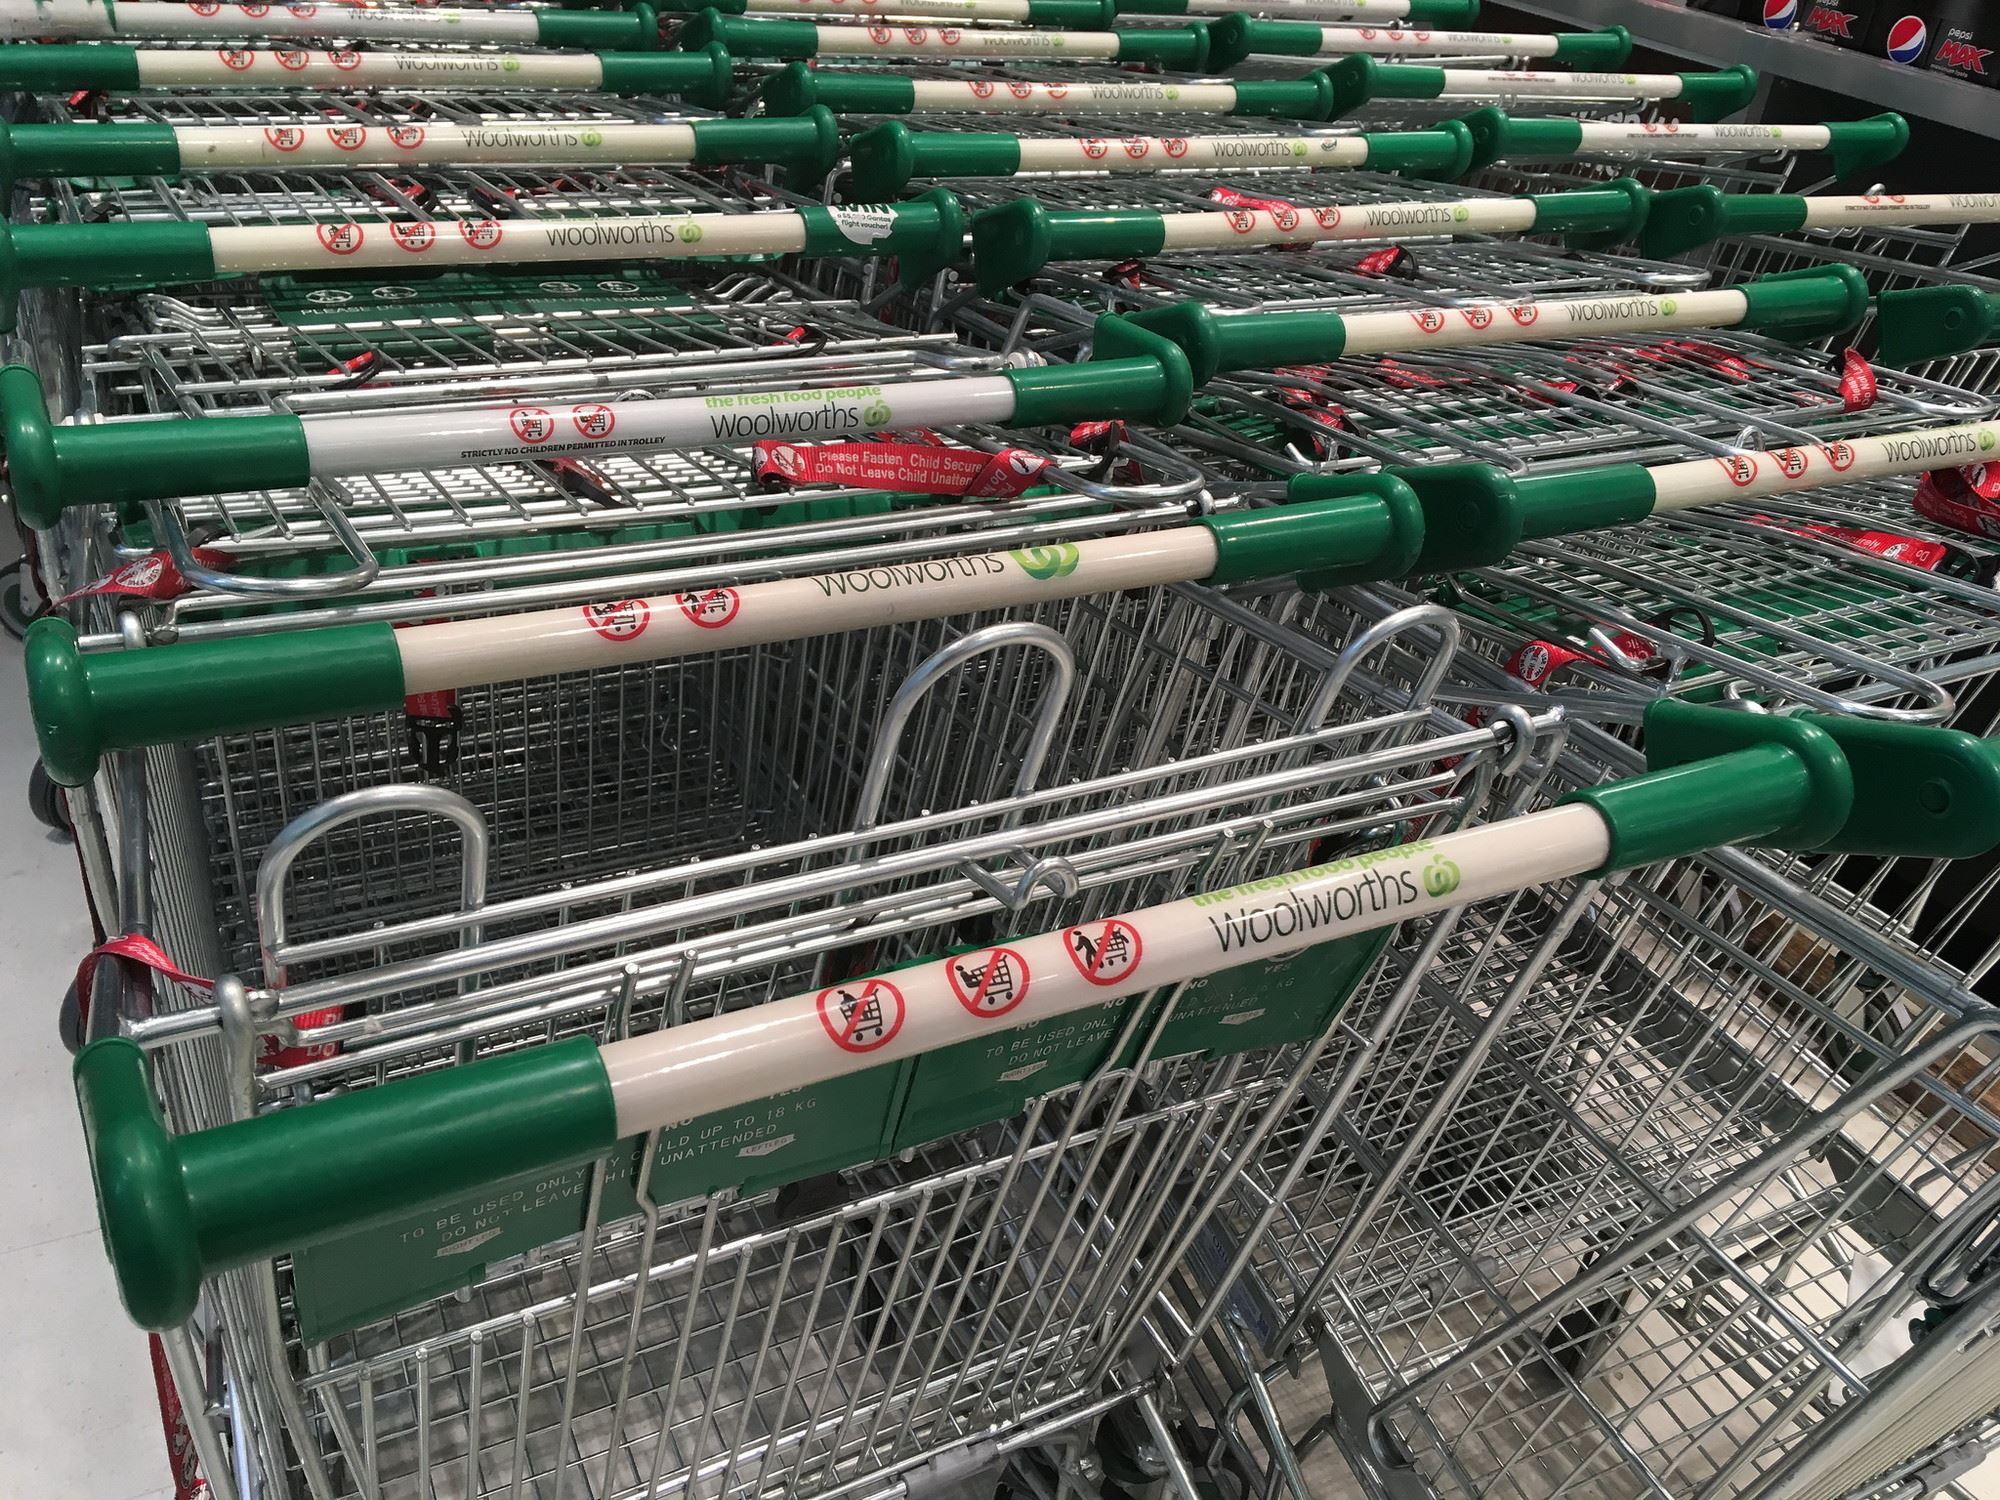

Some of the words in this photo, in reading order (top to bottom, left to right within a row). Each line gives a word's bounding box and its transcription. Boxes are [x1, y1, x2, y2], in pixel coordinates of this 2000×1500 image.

[1805, 5, 1859, 38] MAX
[1947, 28, 1974, 40] pepsi
[1934, 38, 1995, 75] MAX
[462, 129, 578, 148] Woolworths
[1212, 139, 1291, 158] Woolworths
[1366, 206, 1451, 226] Woolworths
[546, 219, 675, 247] Woolworths
[1565, 298, 1658, 322] Woolworths
[705, 396, 734, 409] the
[736, 392, 781, 406] fresh
[783, 389, 823, 403] food
[825, 385, 882, 402] people
[710, 400, 859, 439] Woolworths
[460, 448, 504, 459] STRICTLY
[504, 447, 518, 455] NO
[520, 443, 566, 454] CHILDREN
[566, 440, 617, 451] PERMITTED
[617, 439, 627, 447] IN
[627, 436, 666, 446] TROLLEY
[1881, 430, 1977, 463] Woolworths
[815, 463, 832, 474] Do
[836, 464, 858, 476] Not
[860, 466, 895, 480] Leave
[898, 468, 928, 483] Child
[819, 451, 860, 464] Please
[862, 451, 903, 466] Fasten
[910, 453, 941, 470] Child
[944, 456, 984, 474] Secure
[811, 554, 1005, 597] Woolworths
[1190, 887, 1236, 908] the
[1355, 838, 1434, 871] people
[1208, 867, 1418, 953] Woolworths
[1185, 979, 1209, 991] NO
[1102, 997, 1128, 1010] NO
[986, 1045, 1004, 1059] TO
[1011, 1037, 1031, 1051] BE
[1037, 1025, 1075, 1044] USED
[1082, 1014, 1121, 1031] ONLY
[1008, 1052, 1029, 1066] DO
[1033, 1043, 1060, 1059] NOT
[1066, 1028, 1115, 1049] LEAVE
[400, 1227, 425, 1243] TO
[436, 1212, 462, 1230] BE
[472, 1190, 524, 1217] USED
[535, 1167, 586, 1193] ONLY
[631, 1135, 690, 1163] CILD
[700, 1124, 723, 1140] UP
[733, 1115, 756, 1129] TO
[767, 1106, 786, 1121] 18
[794, 1097, 818, 1113] KG
[441, 1226, 466, 1243] DO
[475, 1206, 514, 1229] NOT
[522, 1183, 585, 1213] LEAVE
[604, 1166, 637, 1185] HIL
[660, 1123, 778, 1166] UNATTENDED
